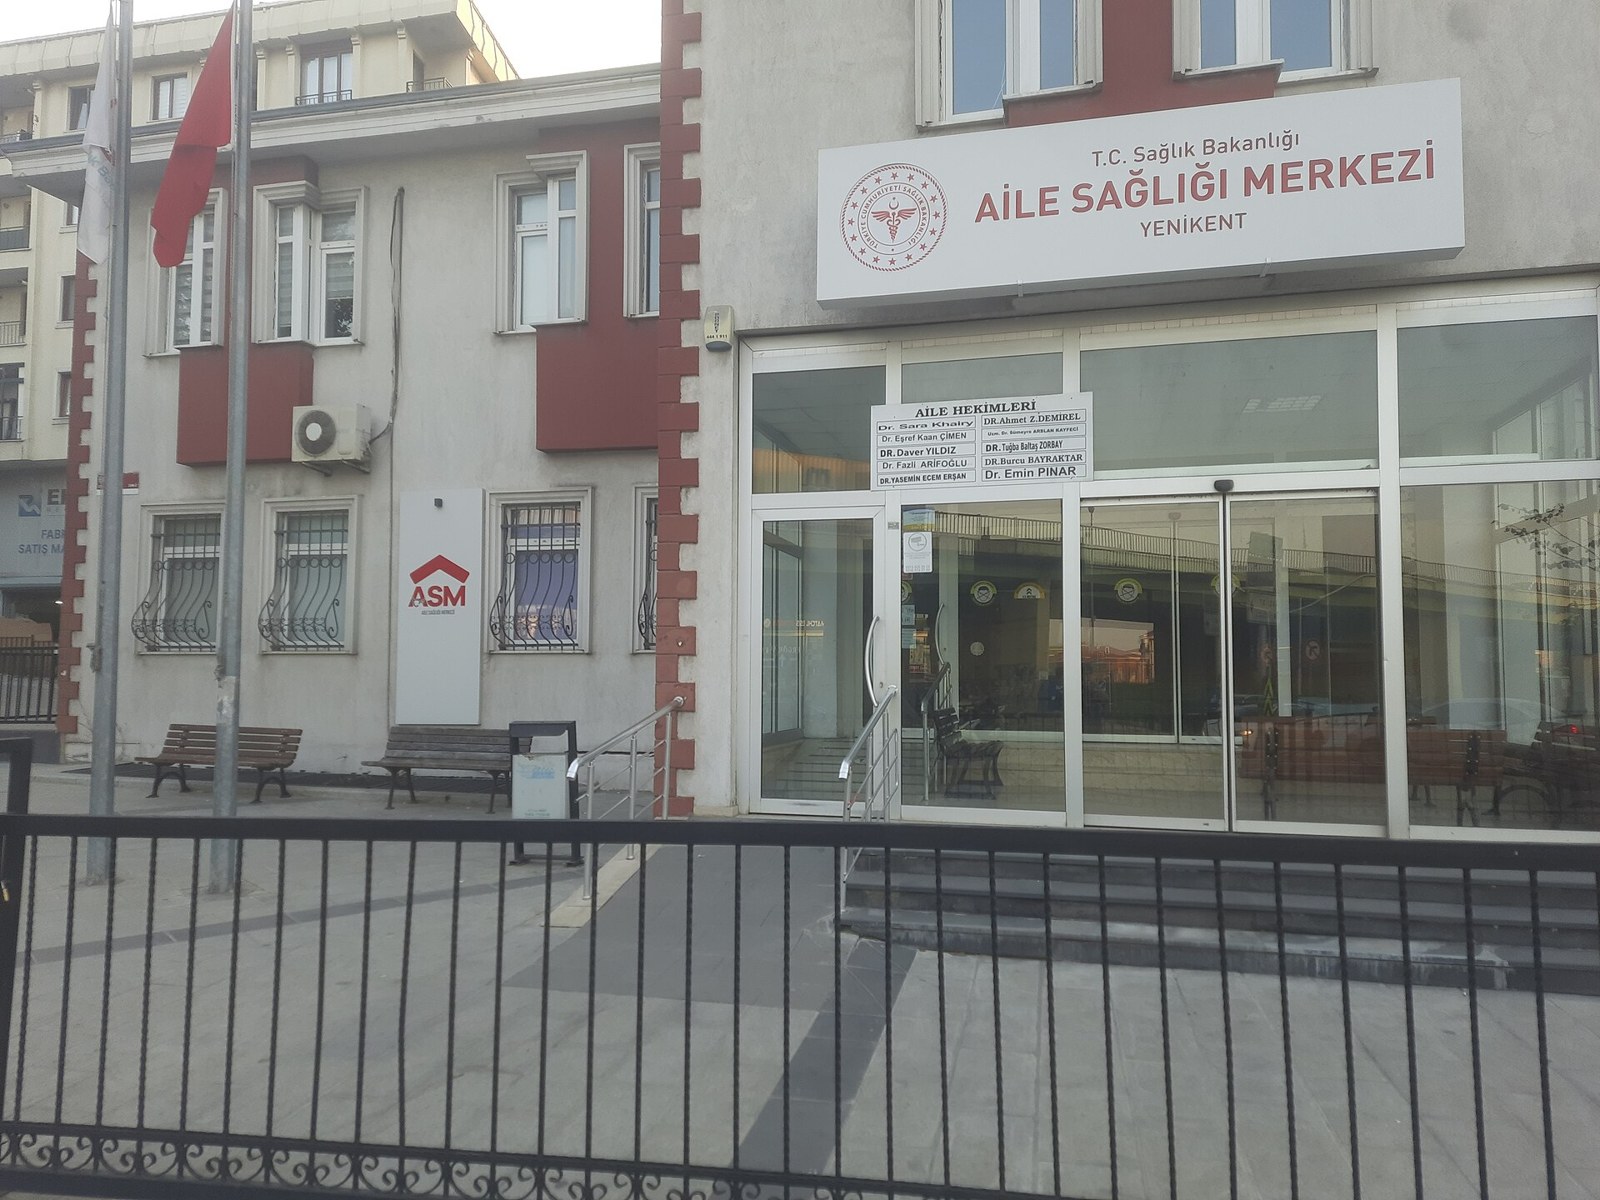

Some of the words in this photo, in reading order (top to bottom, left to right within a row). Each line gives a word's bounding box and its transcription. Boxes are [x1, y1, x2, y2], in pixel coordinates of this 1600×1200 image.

[1092, 149, 1127, 167] T.C.
[1133, 141, 1195, 164] Sağlık
[1203, 129, 1299, 156] Bakanlığı
[974, 183, 1060, 223] AİLE
[1071, 161, 1228, 214] SAĞLIĞI
[1243, 139, 1435, 197] MERKEZİ
[1140, 213, 1248, 238] YENİKENT
[915, 405, 949, 418] AİLE
[952, 398, 1037, 416] HEKİMLERİ
[894, 434, 916, 443] Eşref
[917, 433, 938, 441] Kaan
[939, 431, 967, 441] ÇİMEN
[925, 446, 957, 456] YILDIZ
[1020, 441, 1038, 452] Baltaş
[1039, 439, 1063, 450] ZORBAY
[882, 461, 894, 470] Dr.
[920, 458, 968, 468] ARİFOĞLU
[1027, 453, 1083, 464] BAYRAKTAR
[922, 473, 942, 481] ECEM
[943, 472, 967, 482] ERŞAN
[985, 469, 1001, 480] Dr.
[1004, 468, 1034, 479] Emin
[1037, 466, 1077, 477] PINAR
[408, 585, 466, 608] ASM
